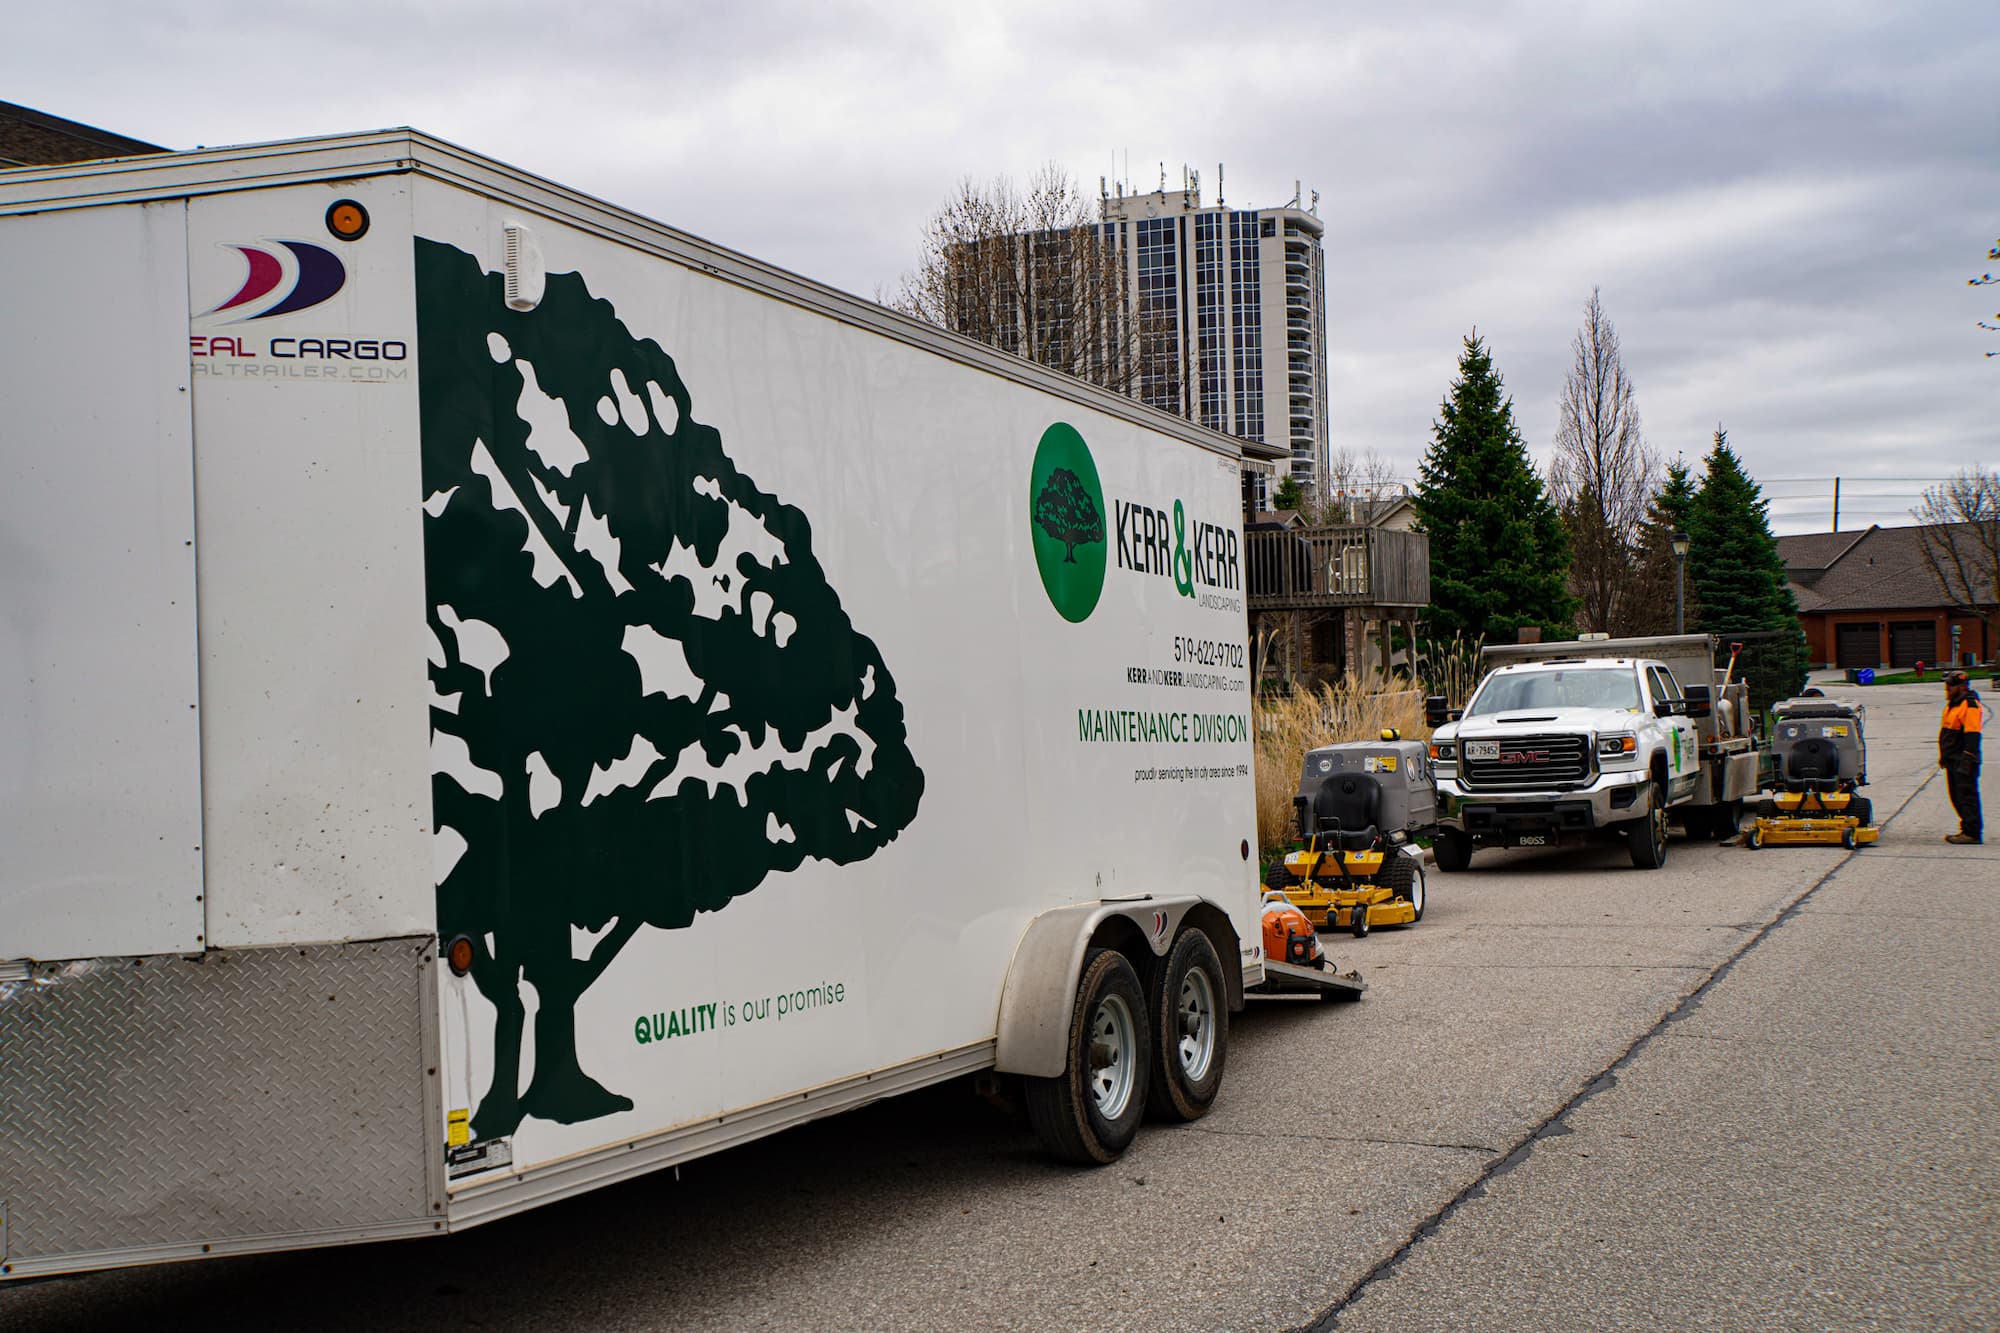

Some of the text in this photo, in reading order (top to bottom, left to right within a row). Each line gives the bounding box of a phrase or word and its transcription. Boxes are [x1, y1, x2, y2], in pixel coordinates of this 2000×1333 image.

[270, 338, 407, 361] CARGO
[1115, 499, 1172, 577] KERR
[1193, 519, 1239, 591] KERR
[1198, 592, 1241, 613] LANDSCAPING
[1174, 636, 1244, 669] 519-622-9702
[1078, 708, 1247, 743] MAINTENANCE DIVISION
[1499, 750, 1550, 764] GMC
[1135, 767, 1157, 783] proudly
[1158, 766, 1184, 783] servicing
[1209, 768, 1220, 778] area
[1221, 766, 1235, 778] since
[1236, 764, 1248, 777] 1994
[1519, 836, 1545, 845] BOSS
[634, 981, 845, 1044] QUALITY is our promise
